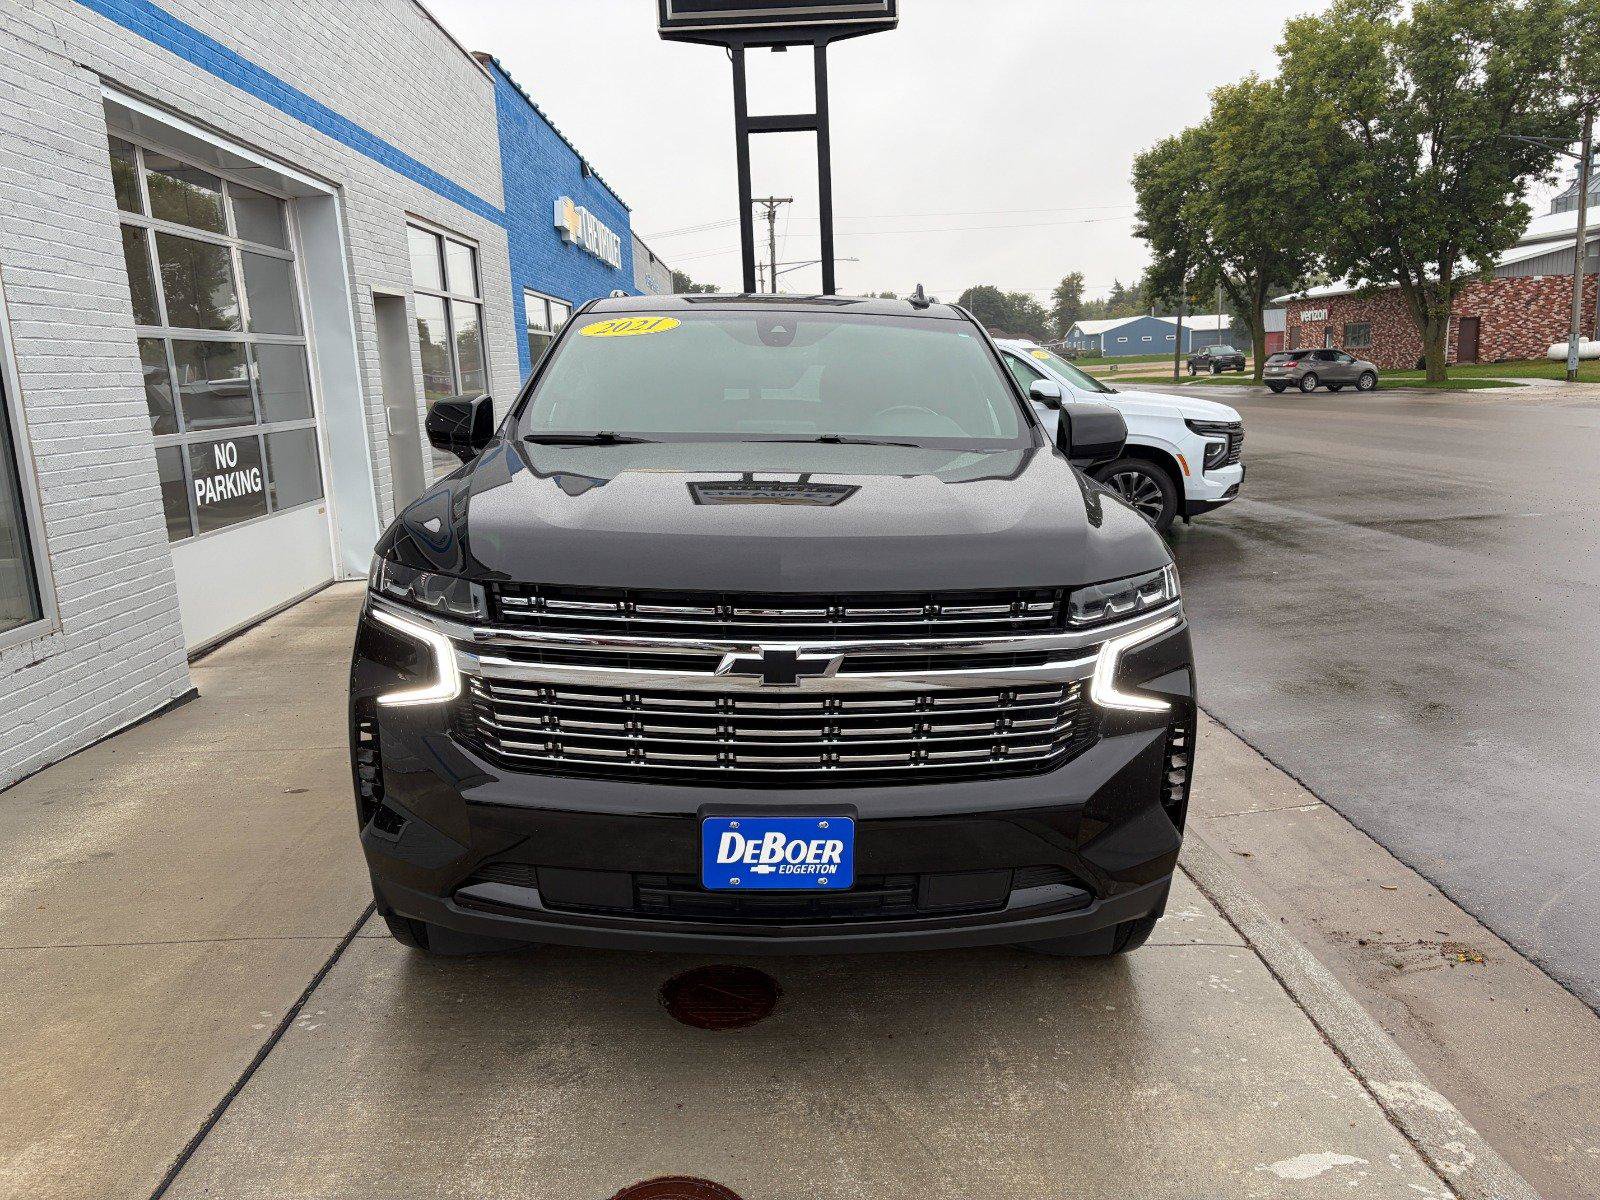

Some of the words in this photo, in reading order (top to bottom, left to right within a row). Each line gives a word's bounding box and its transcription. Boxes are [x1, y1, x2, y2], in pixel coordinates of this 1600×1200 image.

[1300, 308, 1328, 322] verizon
[594, 317, 668, 334] 2021
[213, 441, 238, 469] NO
[194, 467, 262, 506] PARKING
[778, 864, 838, 874] EDGERTON
